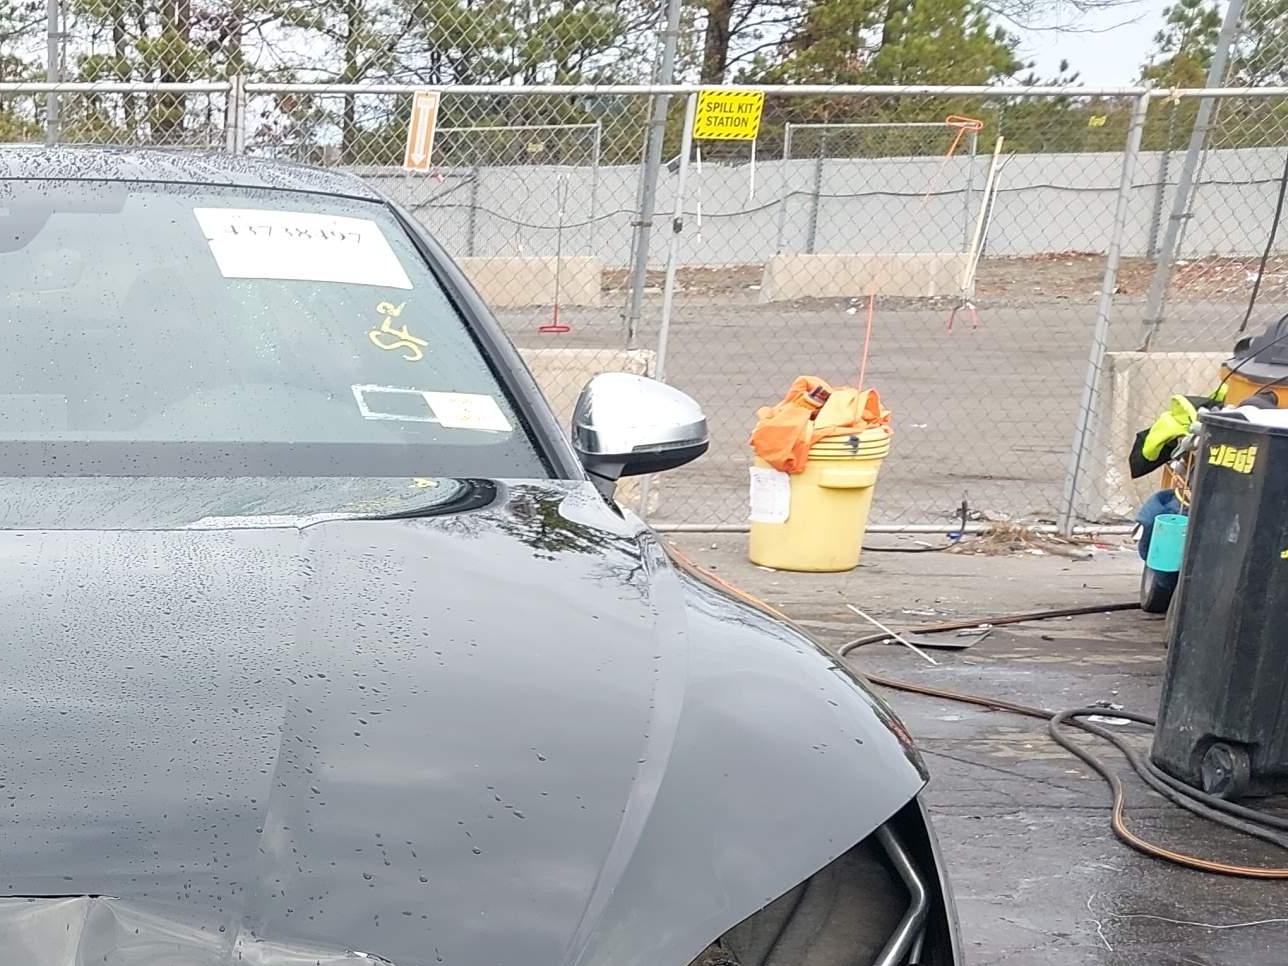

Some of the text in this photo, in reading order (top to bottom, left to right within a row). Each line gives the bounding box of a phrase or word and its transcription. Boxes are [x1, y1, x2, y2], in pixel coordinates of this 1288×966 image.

[706, 102, 754, 113] SPILL KIT
[706, 116, 749, 127] STATION
